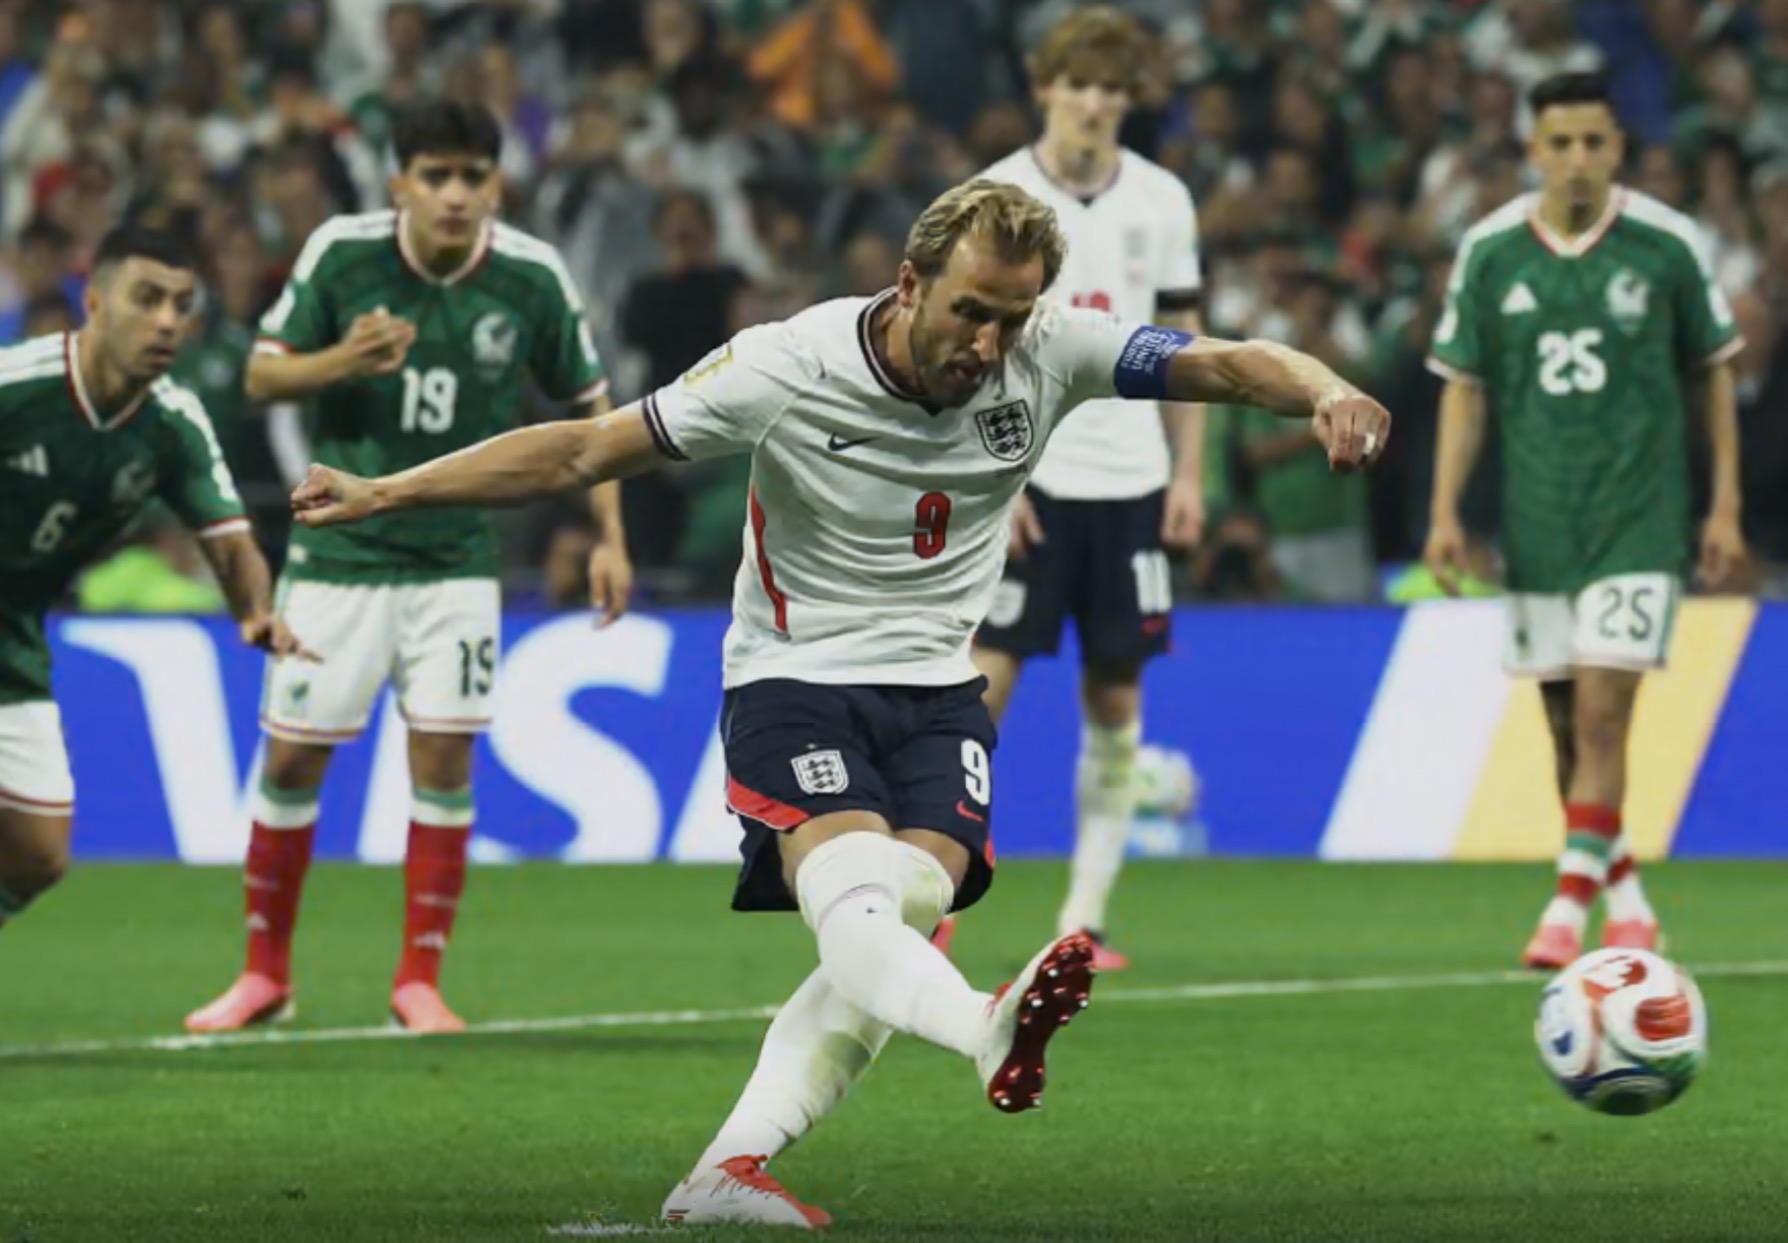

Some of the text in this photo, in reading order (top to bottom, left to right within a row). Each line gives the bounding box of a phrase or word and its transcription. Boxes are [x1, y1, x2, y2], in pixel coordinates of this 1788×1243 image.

[1537, 329, 1606, 394] 25
[402, 368, 457, 433] 19
[31, 502, 77, 552] 6
[914, 492, 951, 559] 9
[1599, 587, 1652, 640] 25
[58, 612, 742, 864] VS
[961, 739, 990, 805] 9
